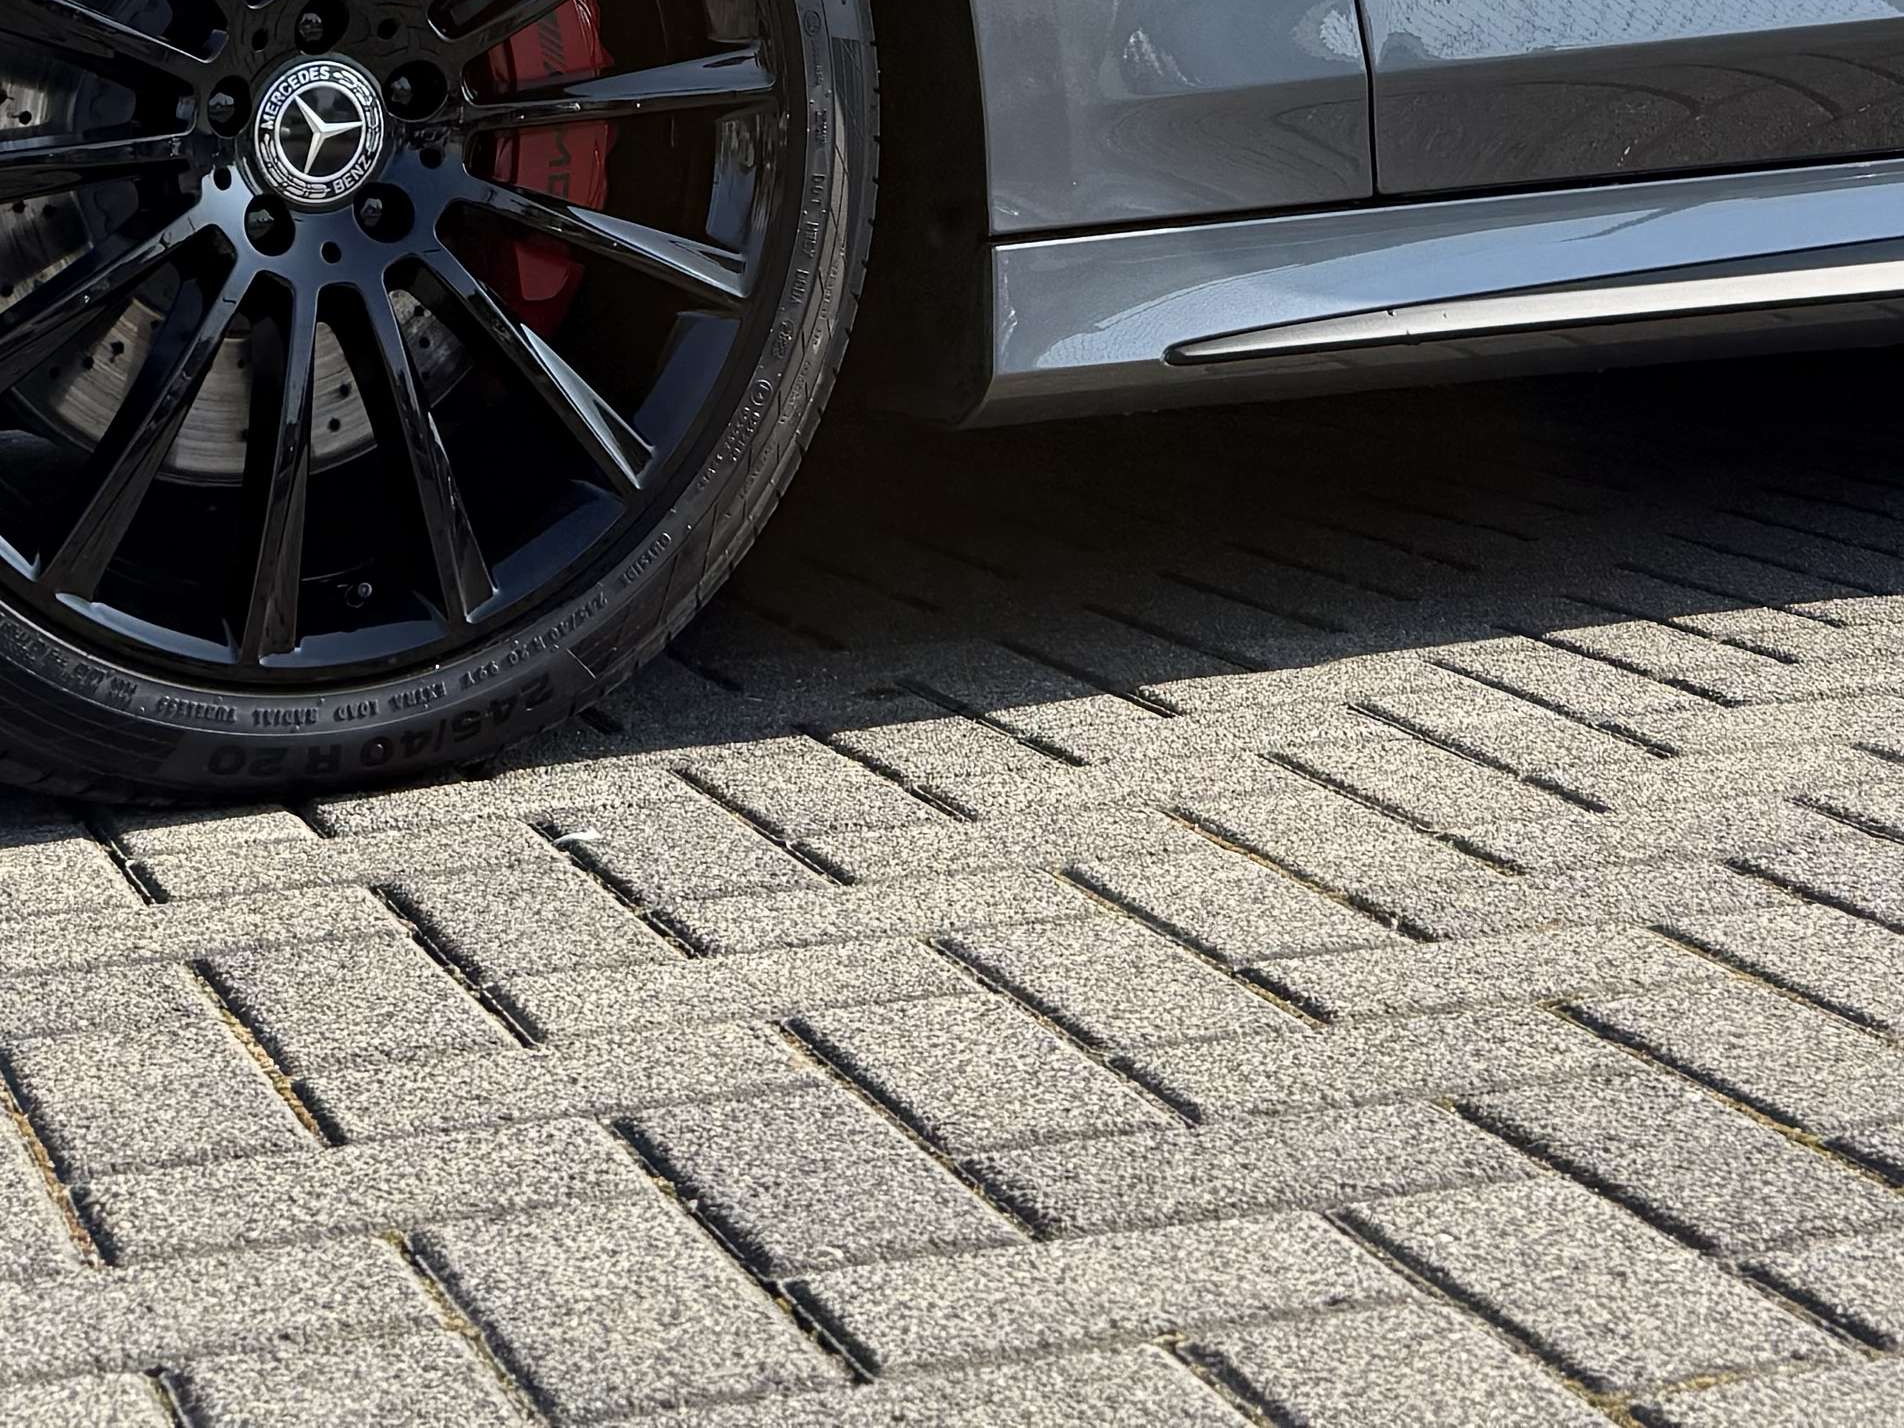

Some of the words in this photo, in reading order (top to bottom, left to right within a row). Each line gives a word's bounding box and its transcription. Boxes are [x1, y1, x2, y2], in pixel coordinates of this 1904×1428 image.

[259, 65, 331, 131] MERCEDES
[333, 156, 373, 195] BENZ
[359, 670, 556, 768] 245/40
[207, 745, 290, 778] 20
[303, 744, 343, 776] R
